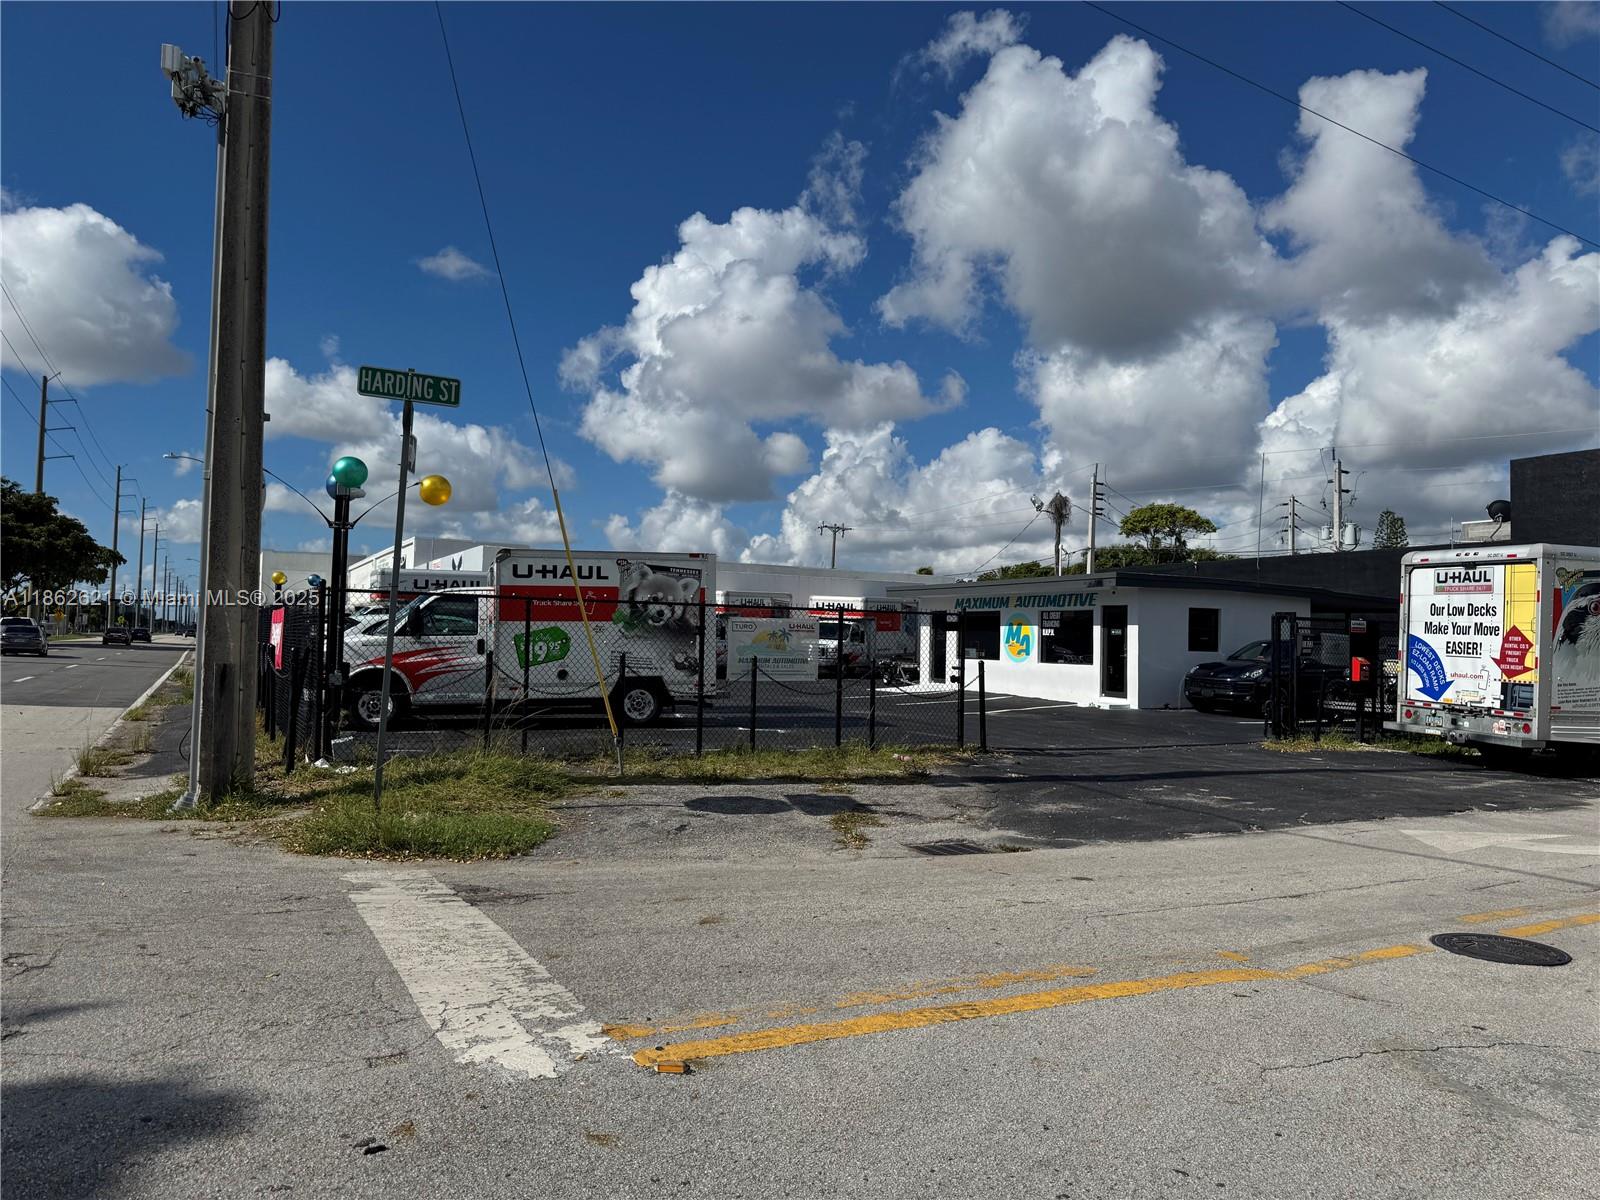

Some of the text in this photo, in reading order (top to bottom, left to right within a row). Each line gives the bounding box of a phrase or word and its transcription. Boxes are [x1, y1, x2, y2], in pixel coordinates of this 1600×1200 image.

[361, 369, 458, 402] HARDING ST
[512, 563, 609, 580] U-HAUL
[670, 567, 699, 575] TENNESSEE
[1436, 570, 1491, 584] U-HAUL
[954, 592, 1098, 609] MAXIMUM AUTOMOTIVE
[1430, 603, 1497, 617] Our Low Decks
[1424, 621, 1500, 636] Make Your Move
[1445, 641, 1482, 656] EASIER!
[1412, 648, 1439, 692] EZ-LOAD RAMP
[1414, 641, 1446, 685] LOWEST DECKS
[1450, 671, 1484, 680] uhaul.com
